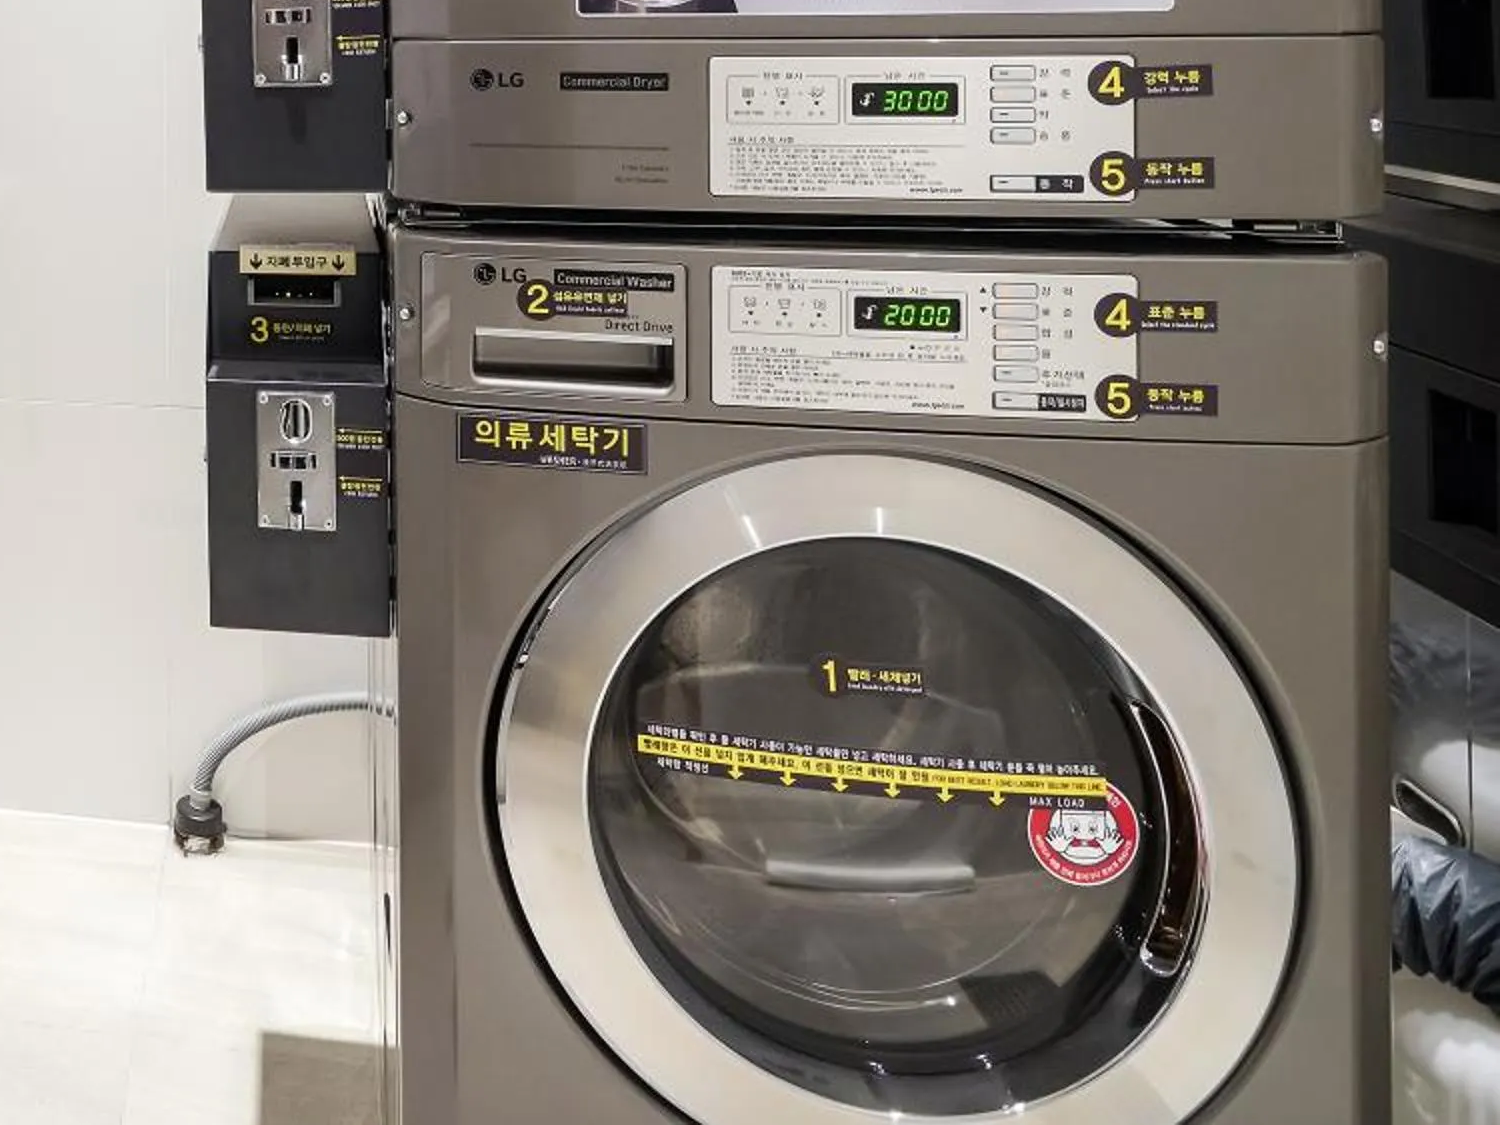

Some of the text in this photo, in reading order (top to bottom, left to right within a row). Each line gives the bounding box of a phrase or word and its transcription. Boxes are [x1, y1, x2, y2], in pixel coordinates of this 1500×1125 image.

[498, 71, 525, 88] LG
[562, 76, 666, 90] Commercial Dryer
[1098, 66, 1125, 98] 4
[1101, 158, 1126, 191] 5
[265, 255, 328, 269] 지폐투입구
[501, 267, 527, 284] LG
[556, 272, 673, 290] Commercial Washer
[526, 283, 550, 314] 2
[604, 318, 673, 334] Direct Drive
[1105, 298, 1131, 331] 4
[1148, 306, 1175, 320] 표준
[250, 316, 269, 343] 3
[1106, 382, 1132, 415] 5
[474, 420, 629, 457] 의류세탁기
[823, 659, 837, 692] 1
[1029, 796, 1085, 808] MAX LOAD
